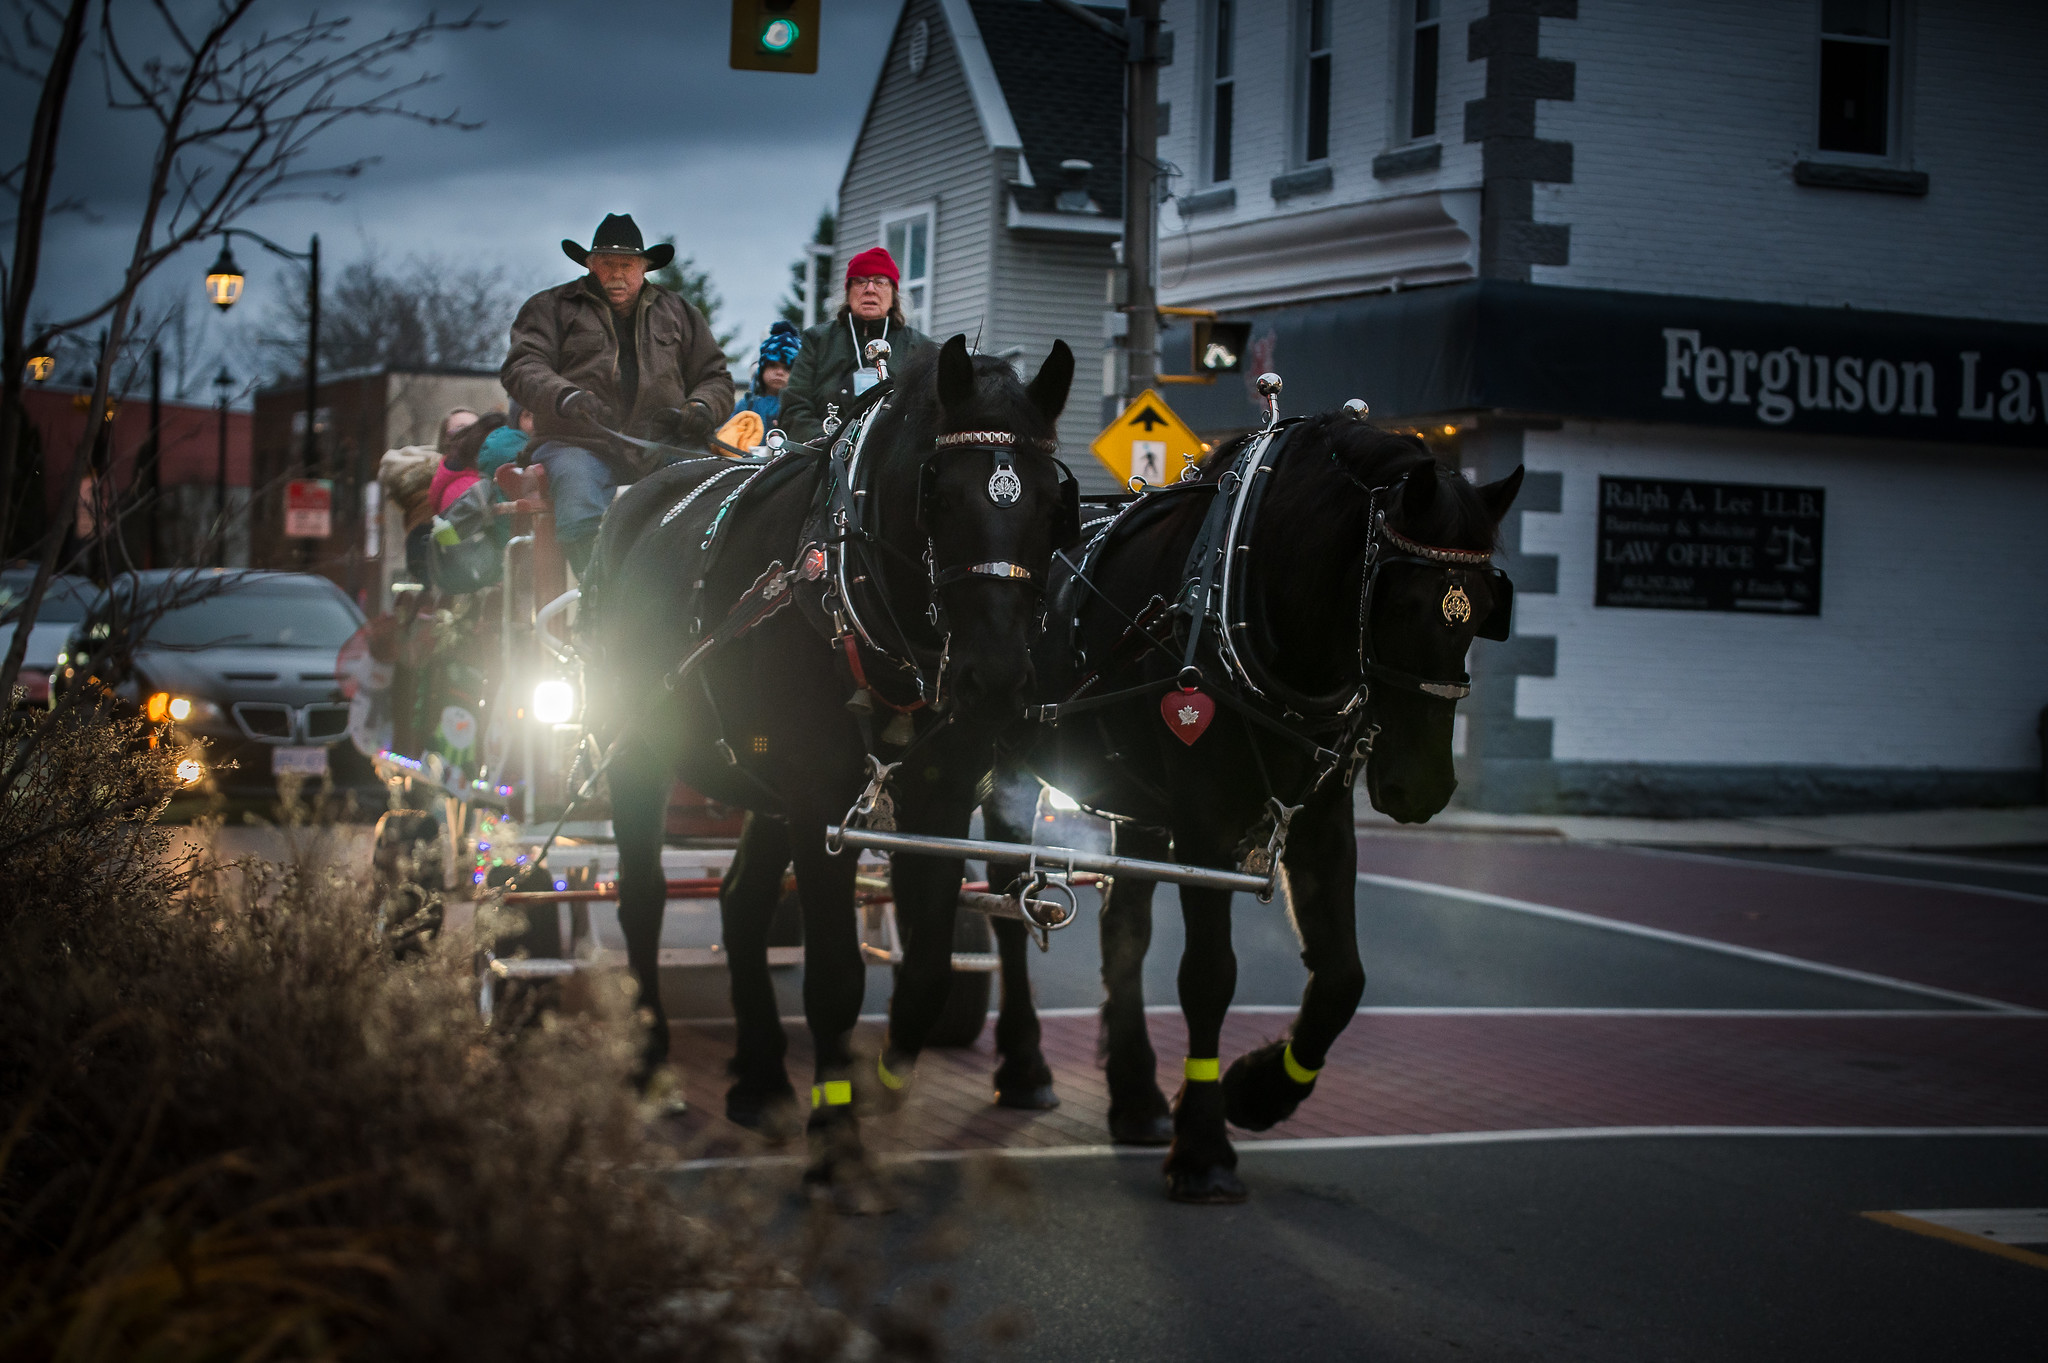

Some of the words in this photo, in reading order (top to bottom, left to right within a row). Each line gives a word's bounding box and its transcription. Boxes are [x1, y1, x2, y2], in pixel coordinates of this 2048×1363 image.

[1661, 328, 1939, 425] Ferguson
[1605, 482, 1670, 513] Ralph
[1678, 486, 1705, 512] A.
[1714, 488, 1752, 514] Lee
[1604, 539, 1660, 565] LAW
[1666, 542, 1756, 569] OFFICE
